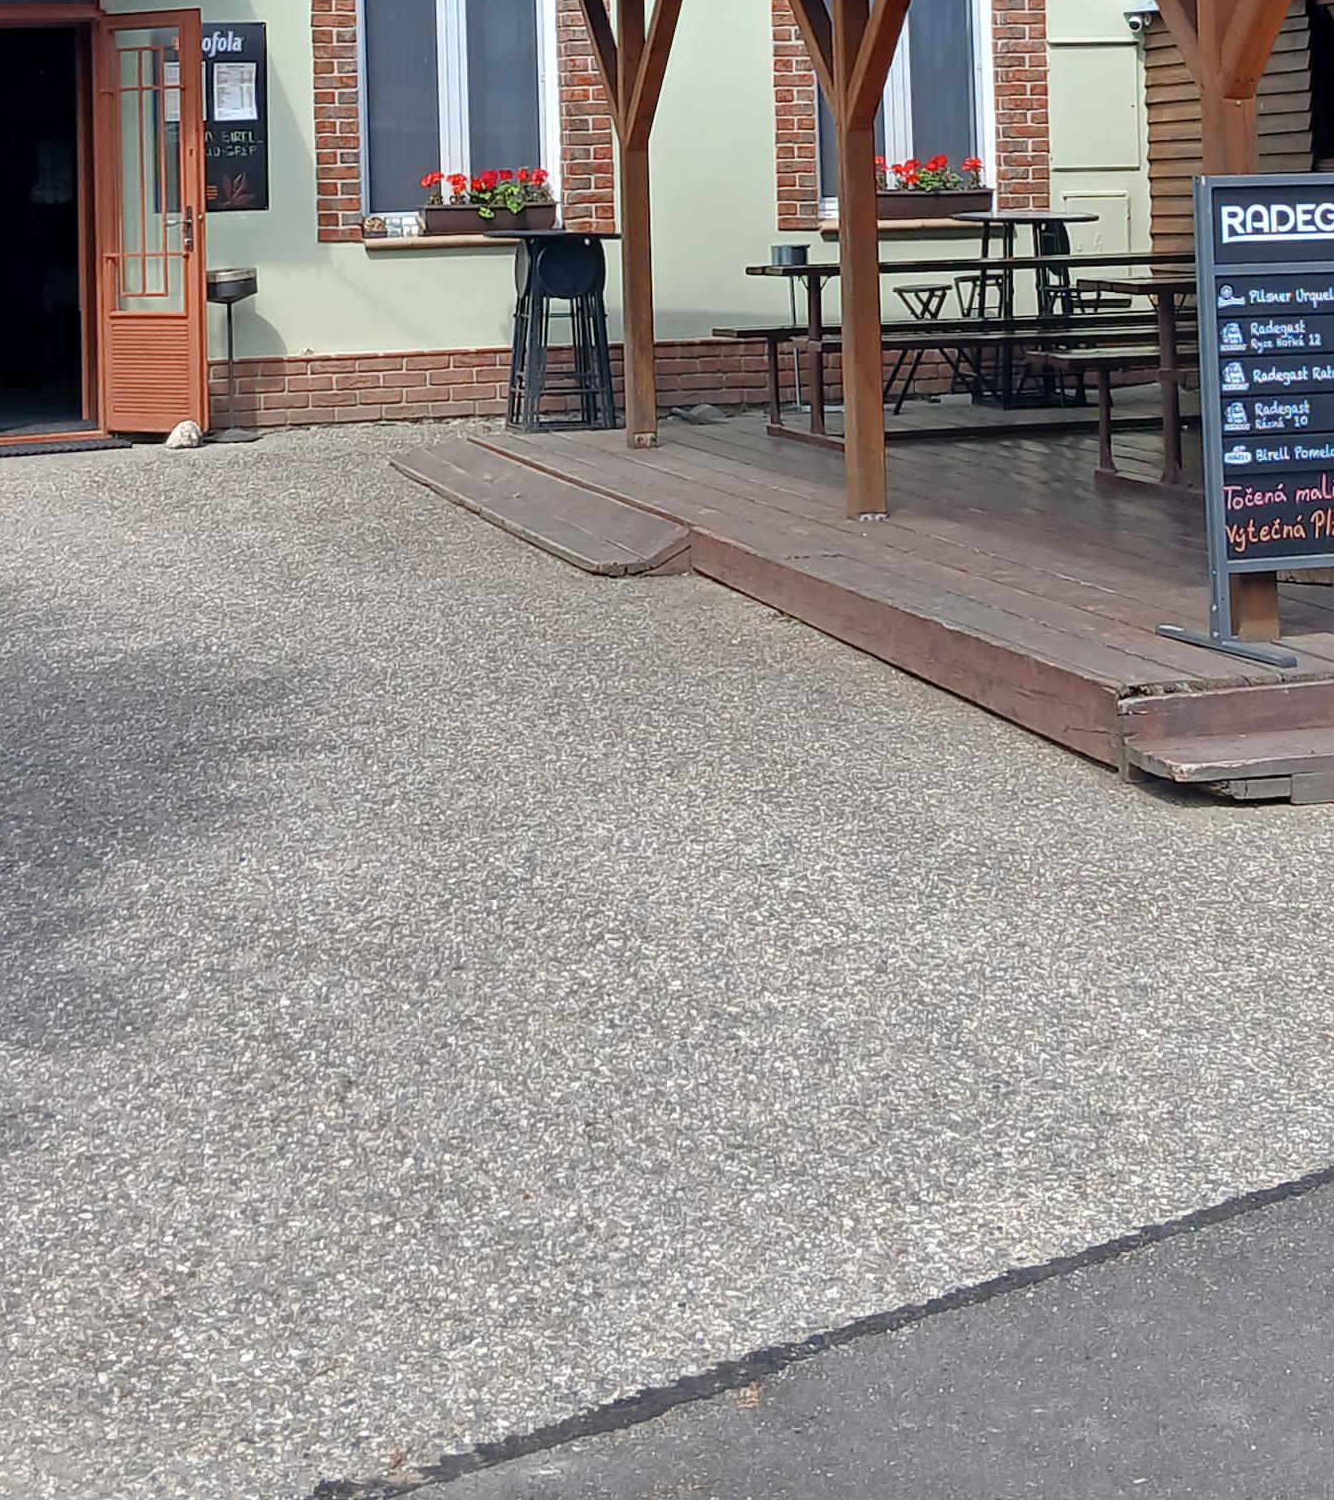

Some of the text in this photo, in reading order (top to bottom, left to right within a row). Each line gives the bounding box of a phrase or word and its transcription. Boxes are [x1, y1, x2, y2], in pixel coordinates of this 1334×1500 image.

[202, 31, 241, 56] ofola
[1249, 289, 1292, 303] Pilsner
[1250, 319, 1306, 338] Radegast
[1308, 333, 1322, 346] 12
[1253, 366, 1309, 386] Radegast
[1254, 400, 1310, 419] Radegast
[1294, 416, 1308, 427] 10
[1255, 446, 1290, 462] Birell
[1223, 484, 1287, 510] Točená
